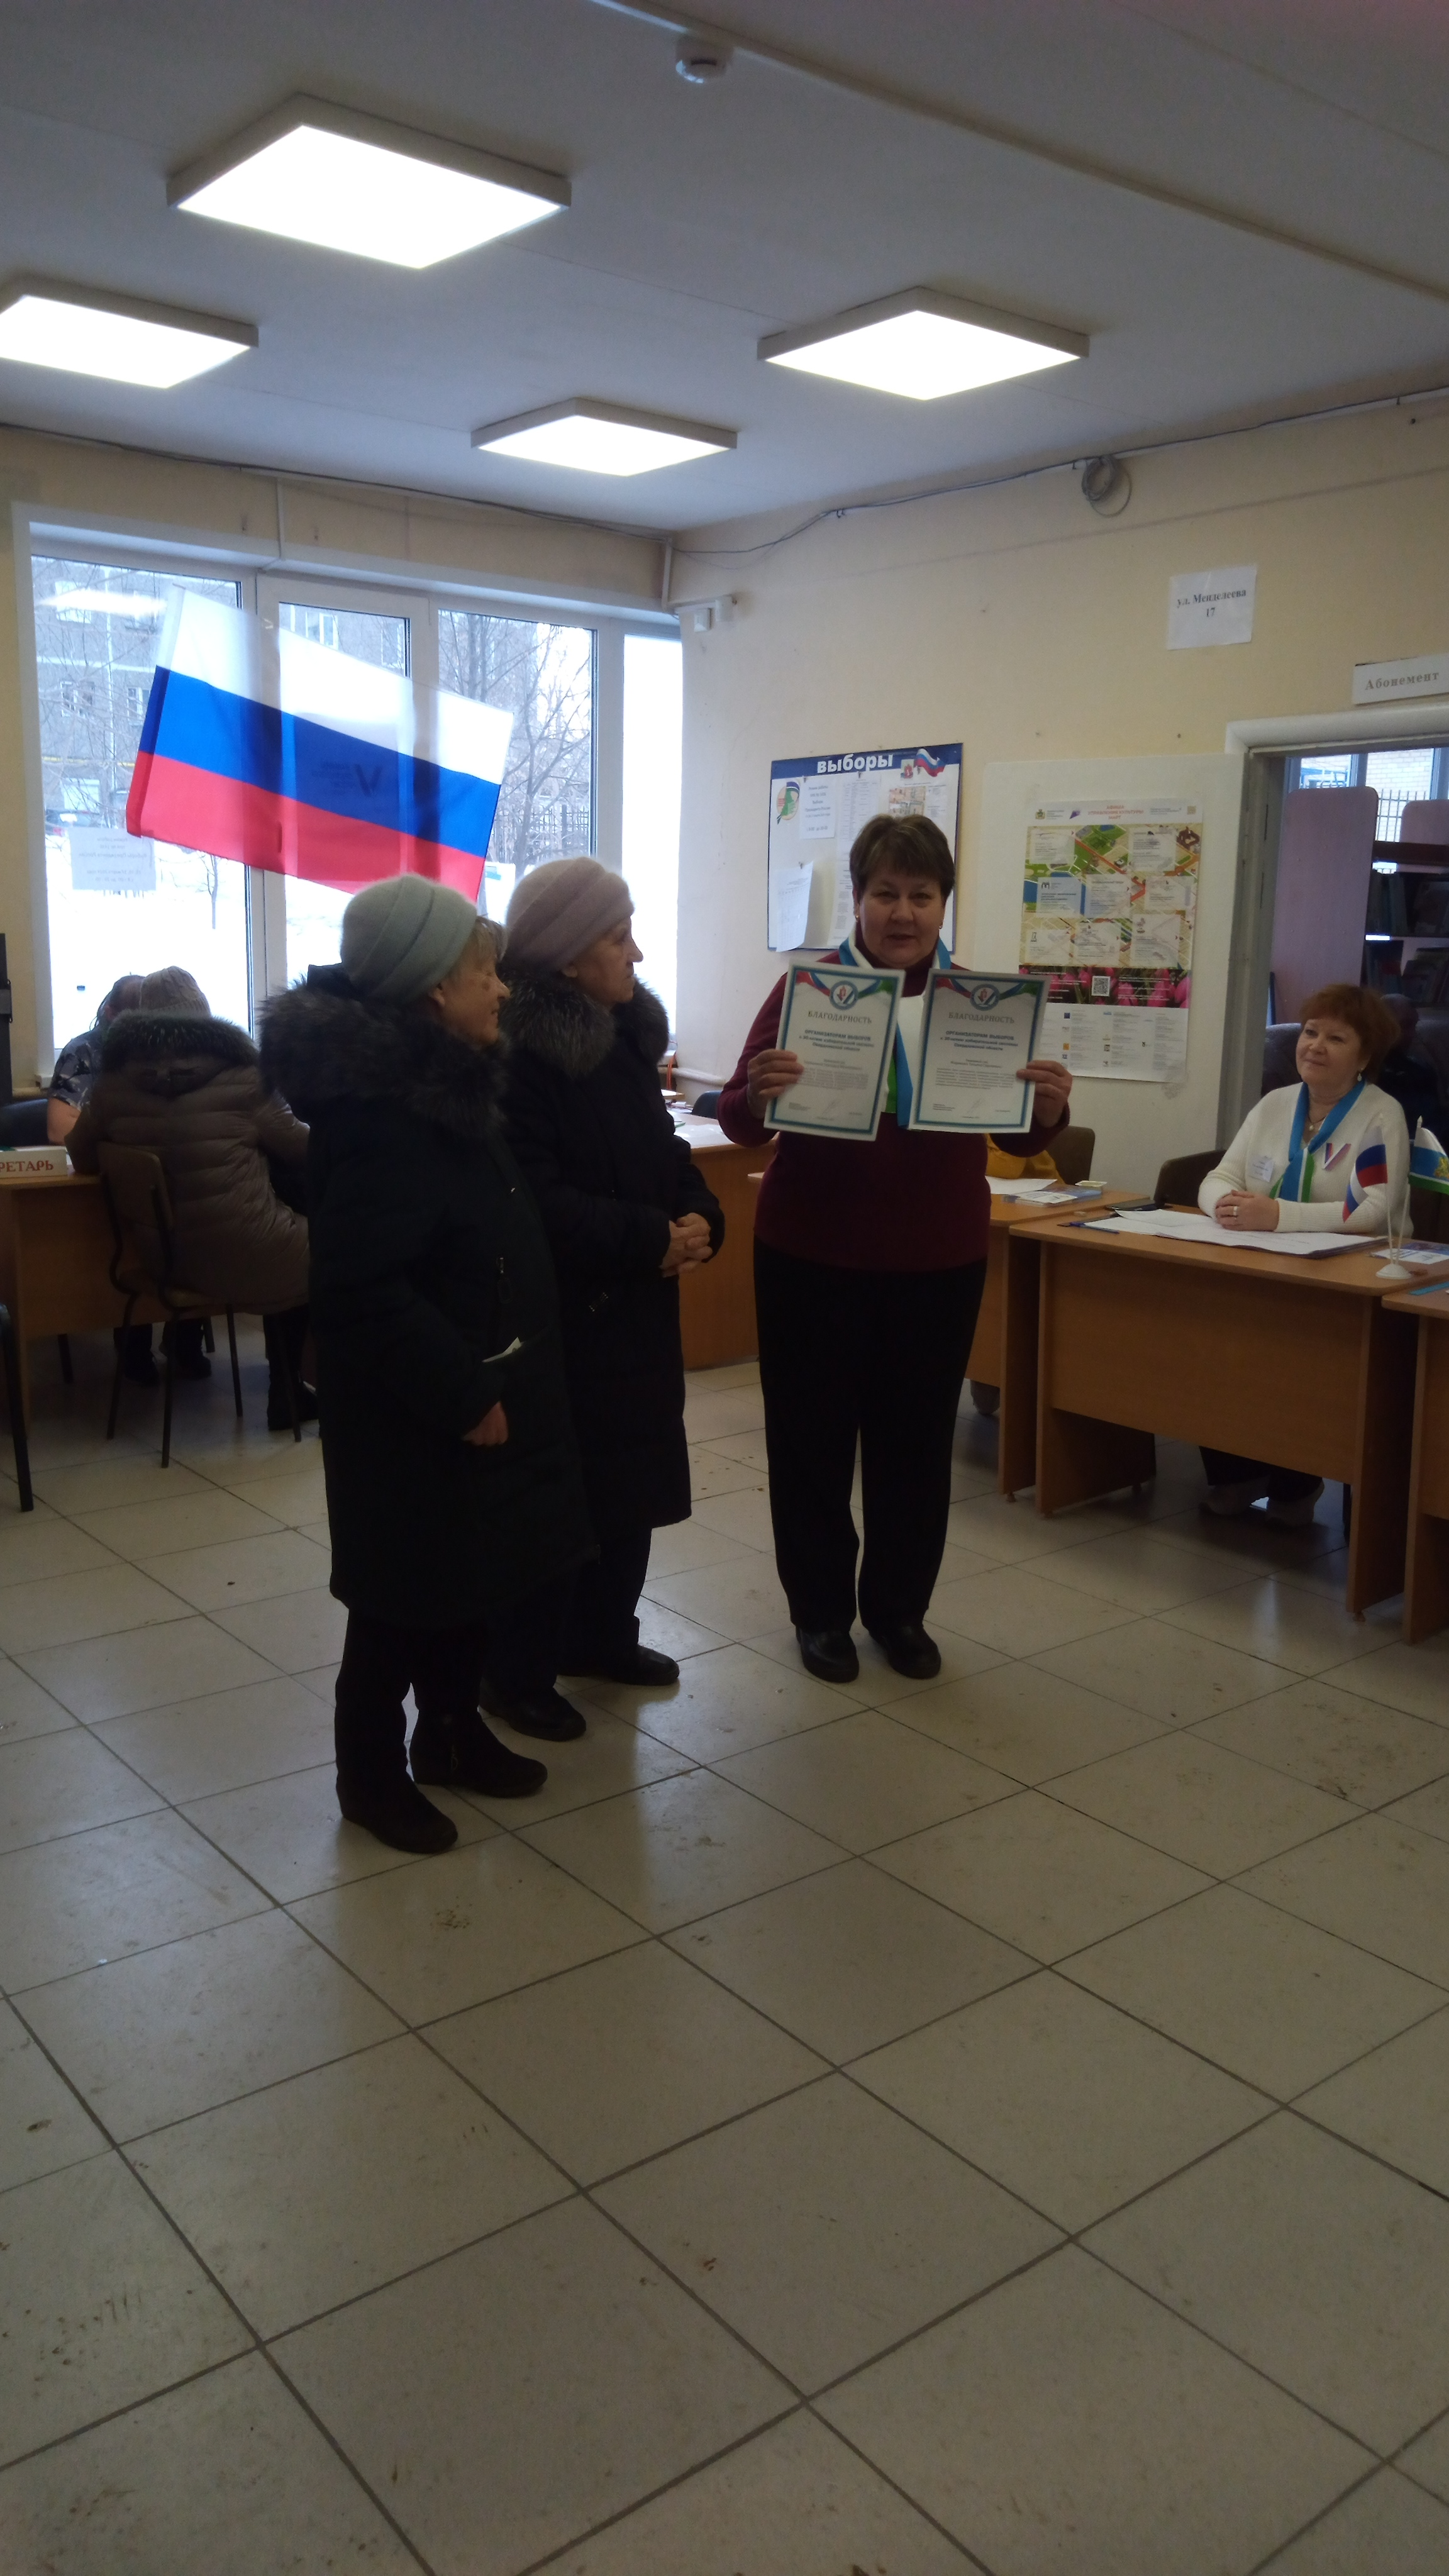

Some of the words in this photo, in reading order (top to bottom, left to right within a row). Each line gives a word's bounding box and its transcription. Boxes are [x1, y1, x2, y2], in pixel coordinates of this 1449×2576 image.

[1177, 599, 1190, 609] ул.
[1192, 589, 1246, 603] Менделеева
[1206, 607, 1216, 617] 17
[1365, 672, 1439, 690] Абонемент
[817, 753, 894, 774] выборы
[808, 1011, 872, 1024] БЛАГОДАРНОСТЬ
[948, 1012, 1015, 1024] БЛАГОДАРНОСТЬ
[804, 1029, 847, 1039] ОРГАНИЗАТОРАМ
[945, 1030, 988, 1038] ОРГАНИЗАТОРАМ
